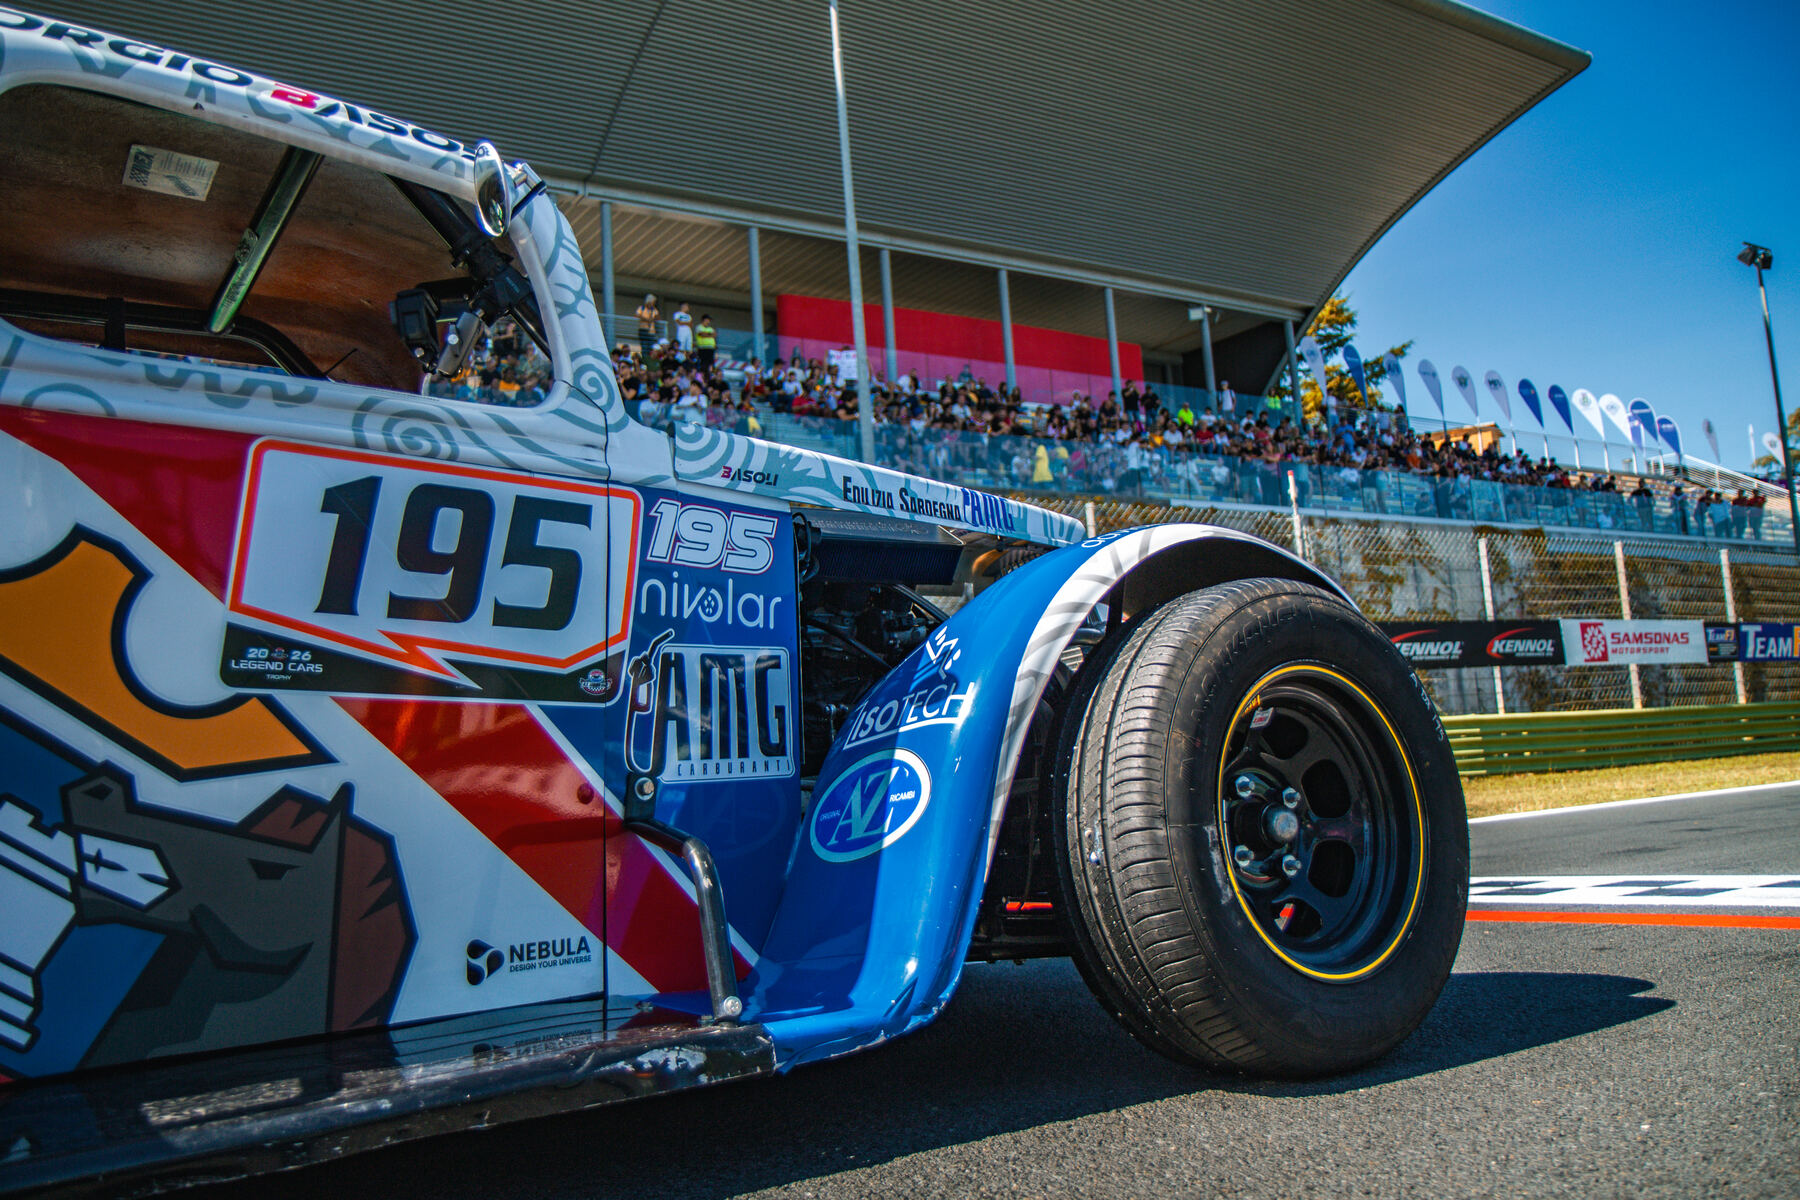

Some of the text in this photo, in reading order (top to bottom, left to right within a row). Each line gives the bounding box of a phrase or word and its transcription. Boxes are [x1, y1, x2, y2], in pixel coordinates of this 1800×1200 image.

[721, 466, 779, 487] BASOLI
[646, 497, 779, 575] 195
[314, 475, 593, 631] 195
[641, 571, 782, 629] nivolar
[1491, 638, 1555, 654] KENNOL
[1611, 631, 1690, 645] SAMSONAS
[247, 647, 269, 658] 20
[290, 650, 312, 661] 26
[1611, 646, 1670, 655] MOTORSPORT
[231, 659, 323, 673] LEGEND CARS
[266, 673, 292, 681] TROPHY
[653, 652, 788, 761] AMG
[850, 681, 975, 741] ISOTECH
[677, 759, 790, 777] CARBURANTI
[889, 789, 916, 803] RICAMBI
[509, 935, 592, 963] NEBULA
[509, 954, 592, 973] DESIGN YOUR UNIVERSE
